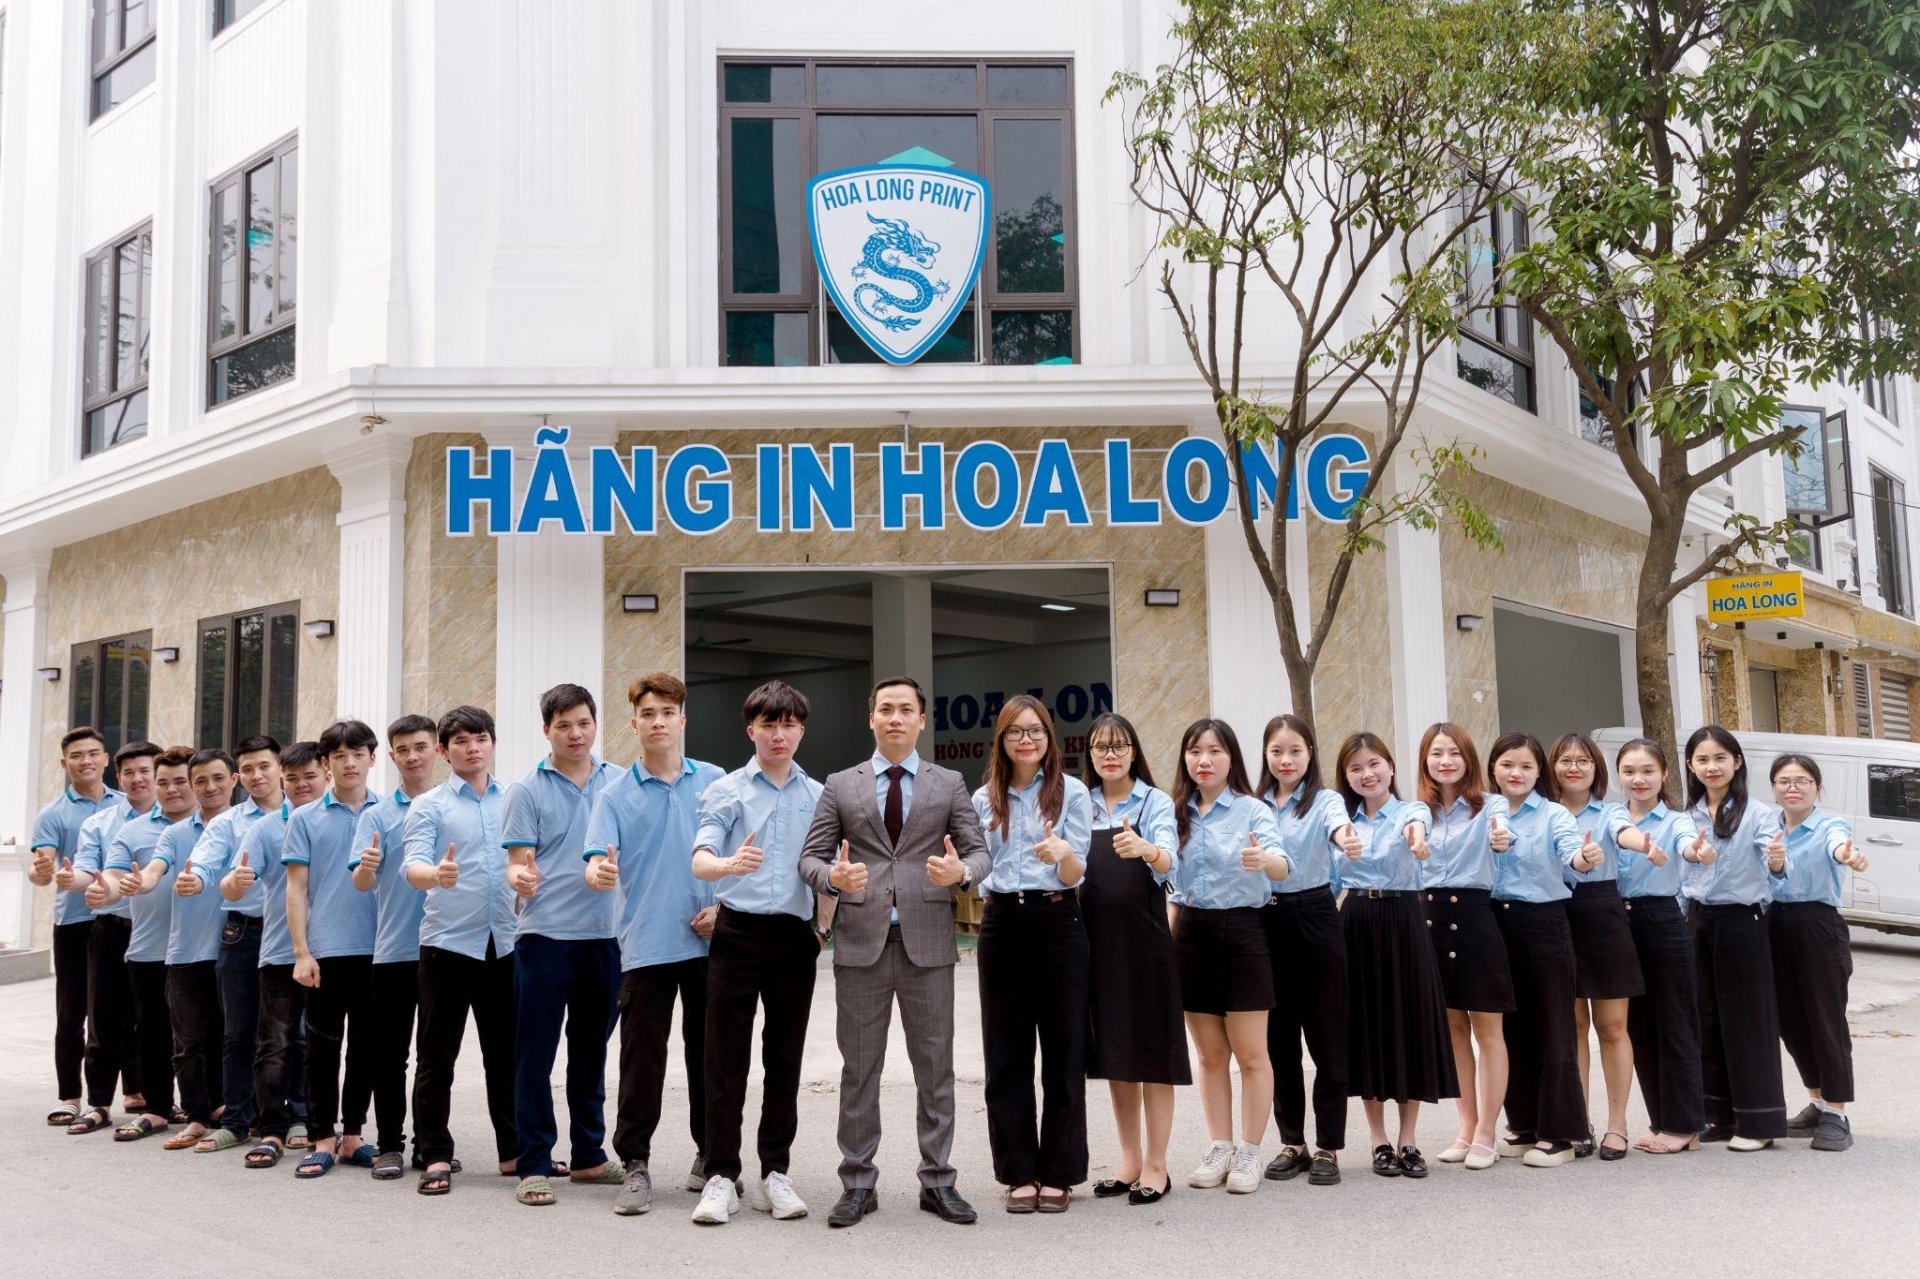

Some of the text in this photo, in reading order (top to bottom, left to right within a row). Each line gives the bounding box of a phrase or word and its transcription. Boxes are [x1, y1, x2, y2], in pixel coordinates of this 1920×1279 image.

[821, 178, 976, 212] HOA LONG PRINT
[446, 425, 1374, 537] HÃNG IN HOA LONG
[1763, 580, 1773, 588] IN
[1713, 592, 1798, 612] HOA LONG
